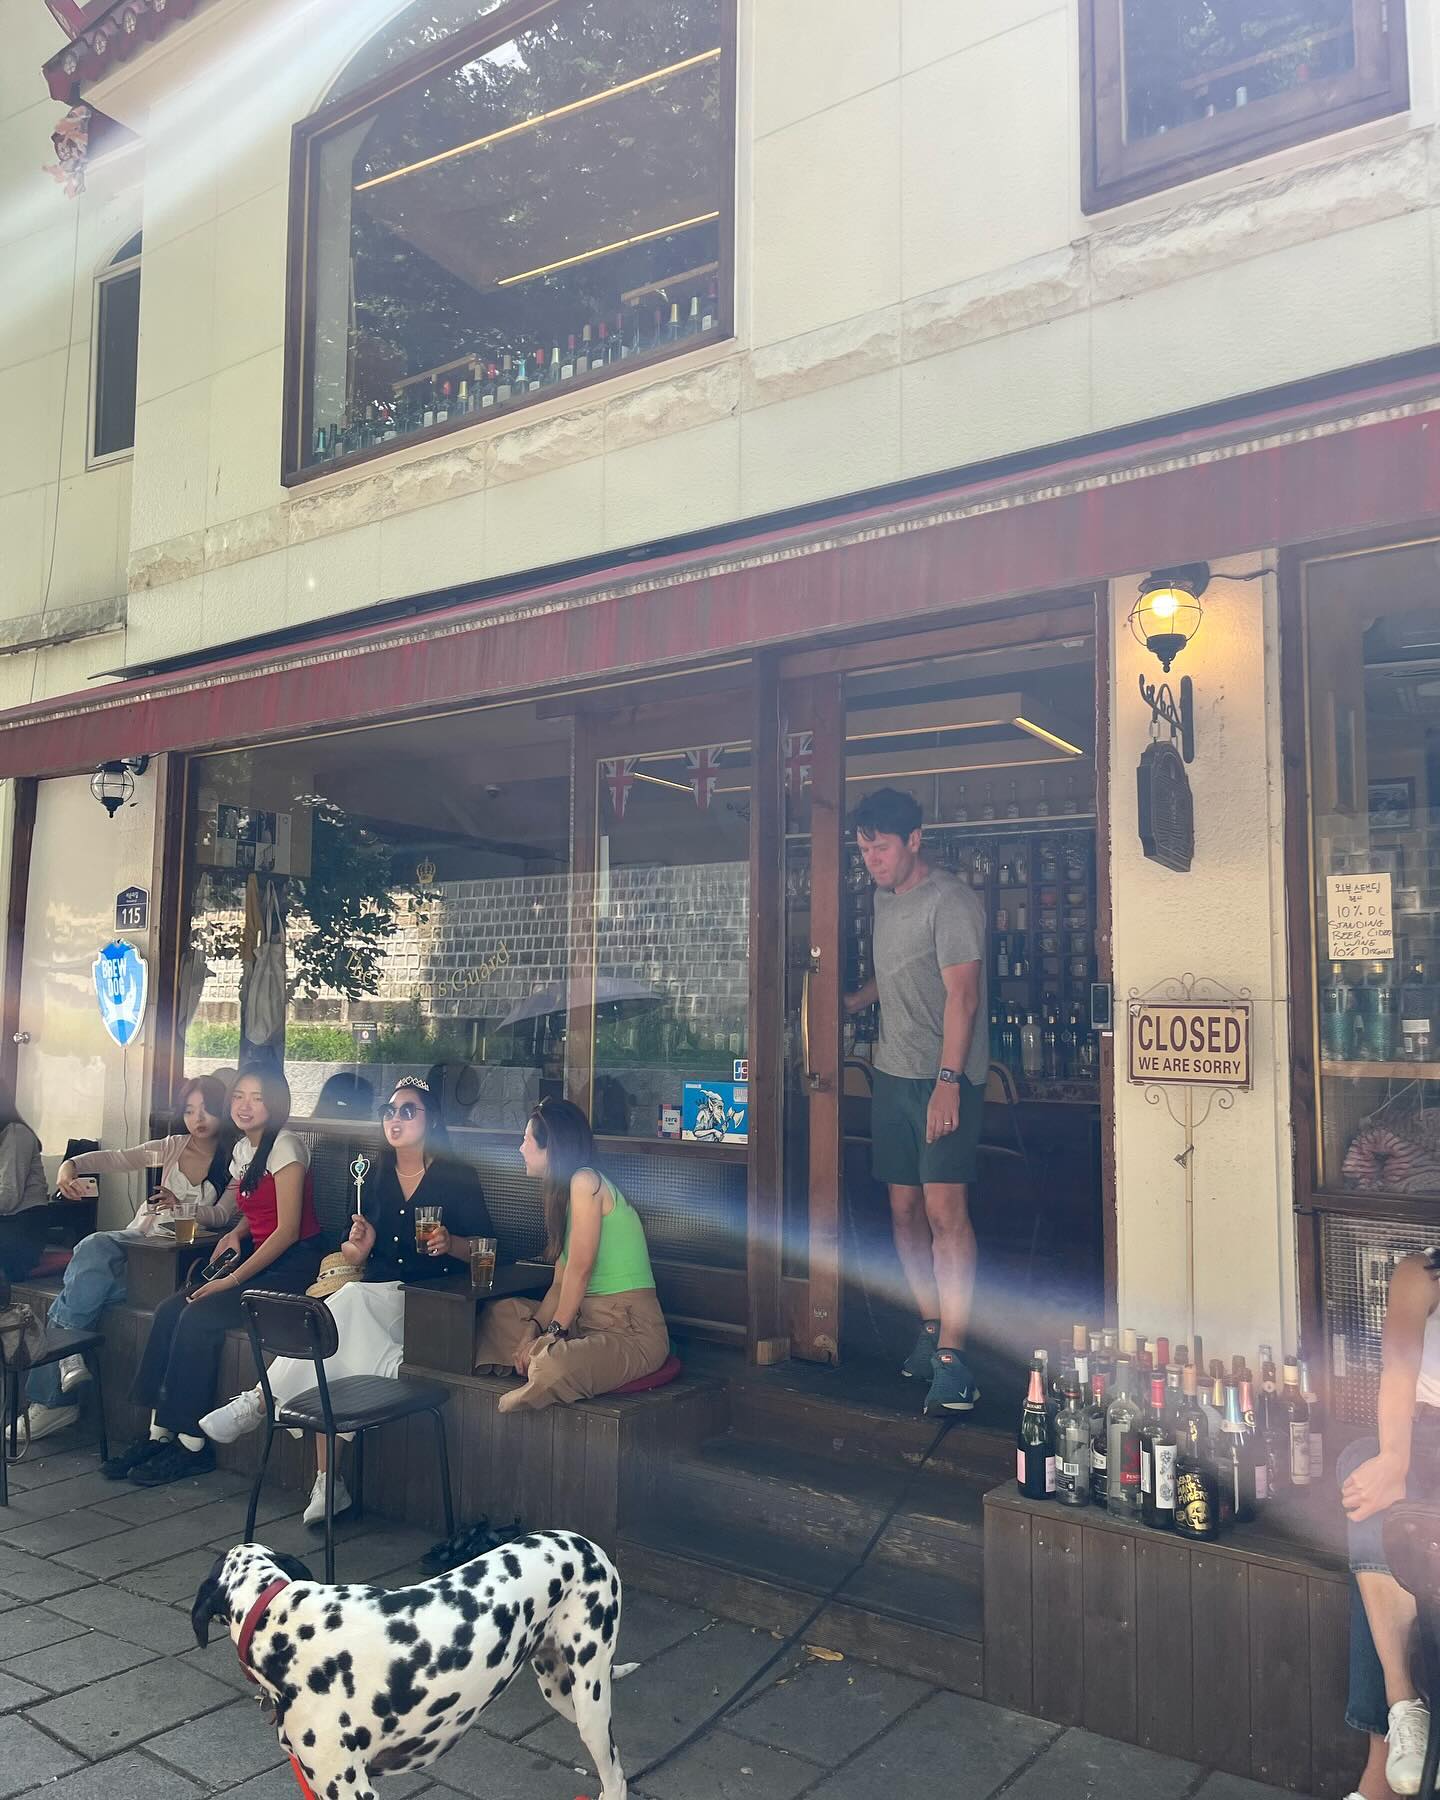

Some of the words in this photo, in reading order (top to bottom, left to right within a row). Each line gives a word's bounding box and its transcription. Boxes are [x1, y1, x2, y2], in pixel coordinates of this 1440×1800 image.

[121, 907, 141, 924] 115
[1337, 905, 1362, 918] 10%
[1328, 919, 1384, 929] STANDING
[1343, 939, 1376, 947] WINE
[1333, 947, 1359, 957] 10%
[102, 957, 127, 978] BREW
[343, 949, 373, 986] The
[376, 971, 447, 998] Qen's
[451, 940, 511, 992] Guard
[107, 977, 125, 997] DOG
[1138, 1015, 1241, 1053] CLOSED
[1138, 1057, 1159, 1071] WE
[1162, 1058, 1190, 1072] ARE
[1193, 1059, 1241, 1074] SORRY
